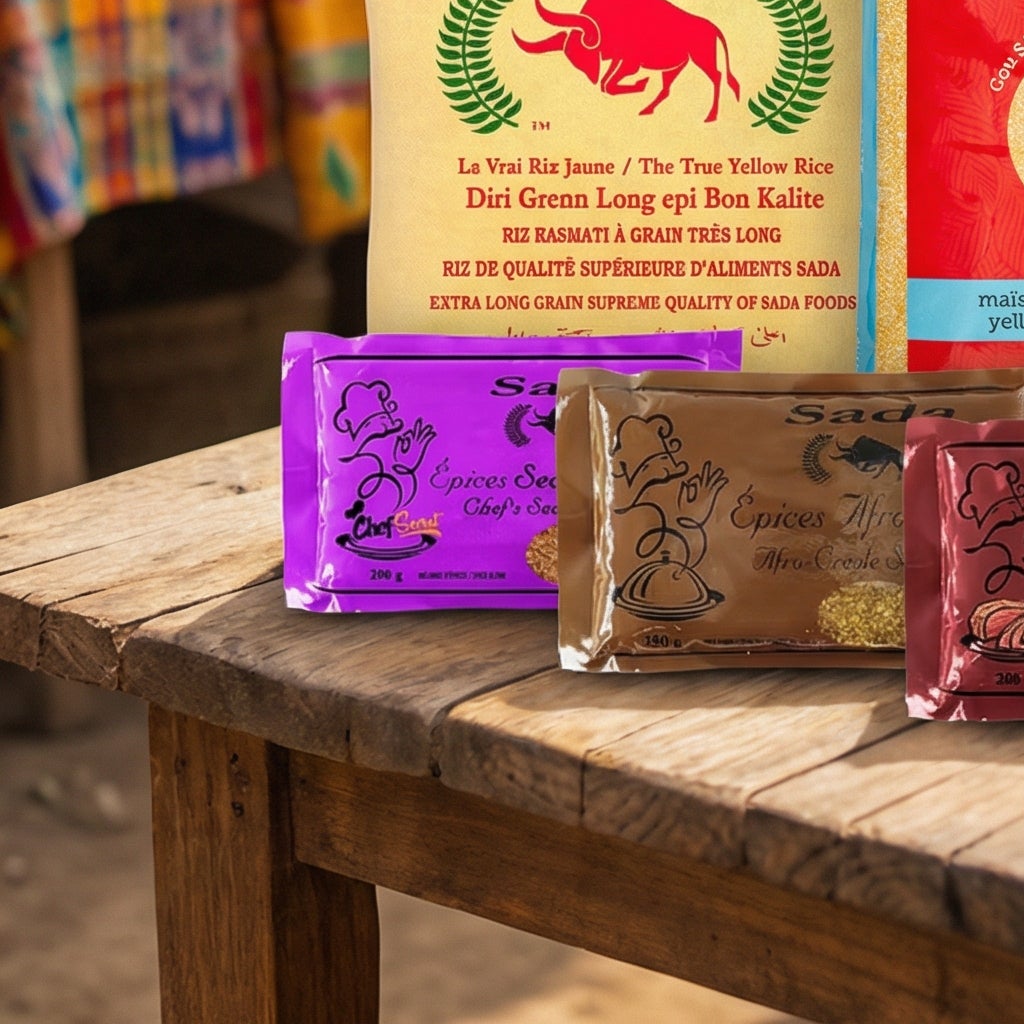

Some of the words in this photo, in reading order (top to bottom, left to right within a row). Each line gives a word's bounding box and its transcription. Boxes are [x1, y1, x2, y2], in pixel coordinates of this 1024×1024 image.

[458, 158, 480, 174] La
[485, 158, 522, 174] Vrai
[528, 158, 560, 174] Riz
[562, 158, 615, 179] Jaune
[638, 157, 674, 174] The
[680, 158, 723, 174] True
[728, 157, 788, 174] Yellow
[795, 157, 834, 174] Rice
[466, 187, 512, 208] Diri
[518, 187, 589, 209] Grenn
[596, 187, 656, 215] Long
[662, 187, 697, 215] epi
[704, 187, 750, 209] Bon
[757, 186, 825, 209] Kalite
[502, 227, 530, 243] RIZ
[534, 227, 610, 243] RASMATI
[614, 223, 626, 243] À
[630, 227, 683, 243] GRAIN
[735, 227, 782, 243] LONG
[442, 261, 471, 277] RIZ
[475, 261, 499, 277] DE
[690, 260, 792, 277] D'ALIMENTS
[796, 261, 841, 277] SADA
[429, 295, 482, 310] EXTRA
[486, 295, 530, 310] LONG
[534, 295, 583, 310] GRAIN
[587, 295, 661, 310] SUPREME
[665, 295, 733, 313] QUALITY
[736, 295, 758, 310] OF
[761, 295, 800, 310] SADA
[804, 295, 856, 310] FOODS
[430, 457, 508, 496] Épices
[730, 484, 825, 530] Épices
